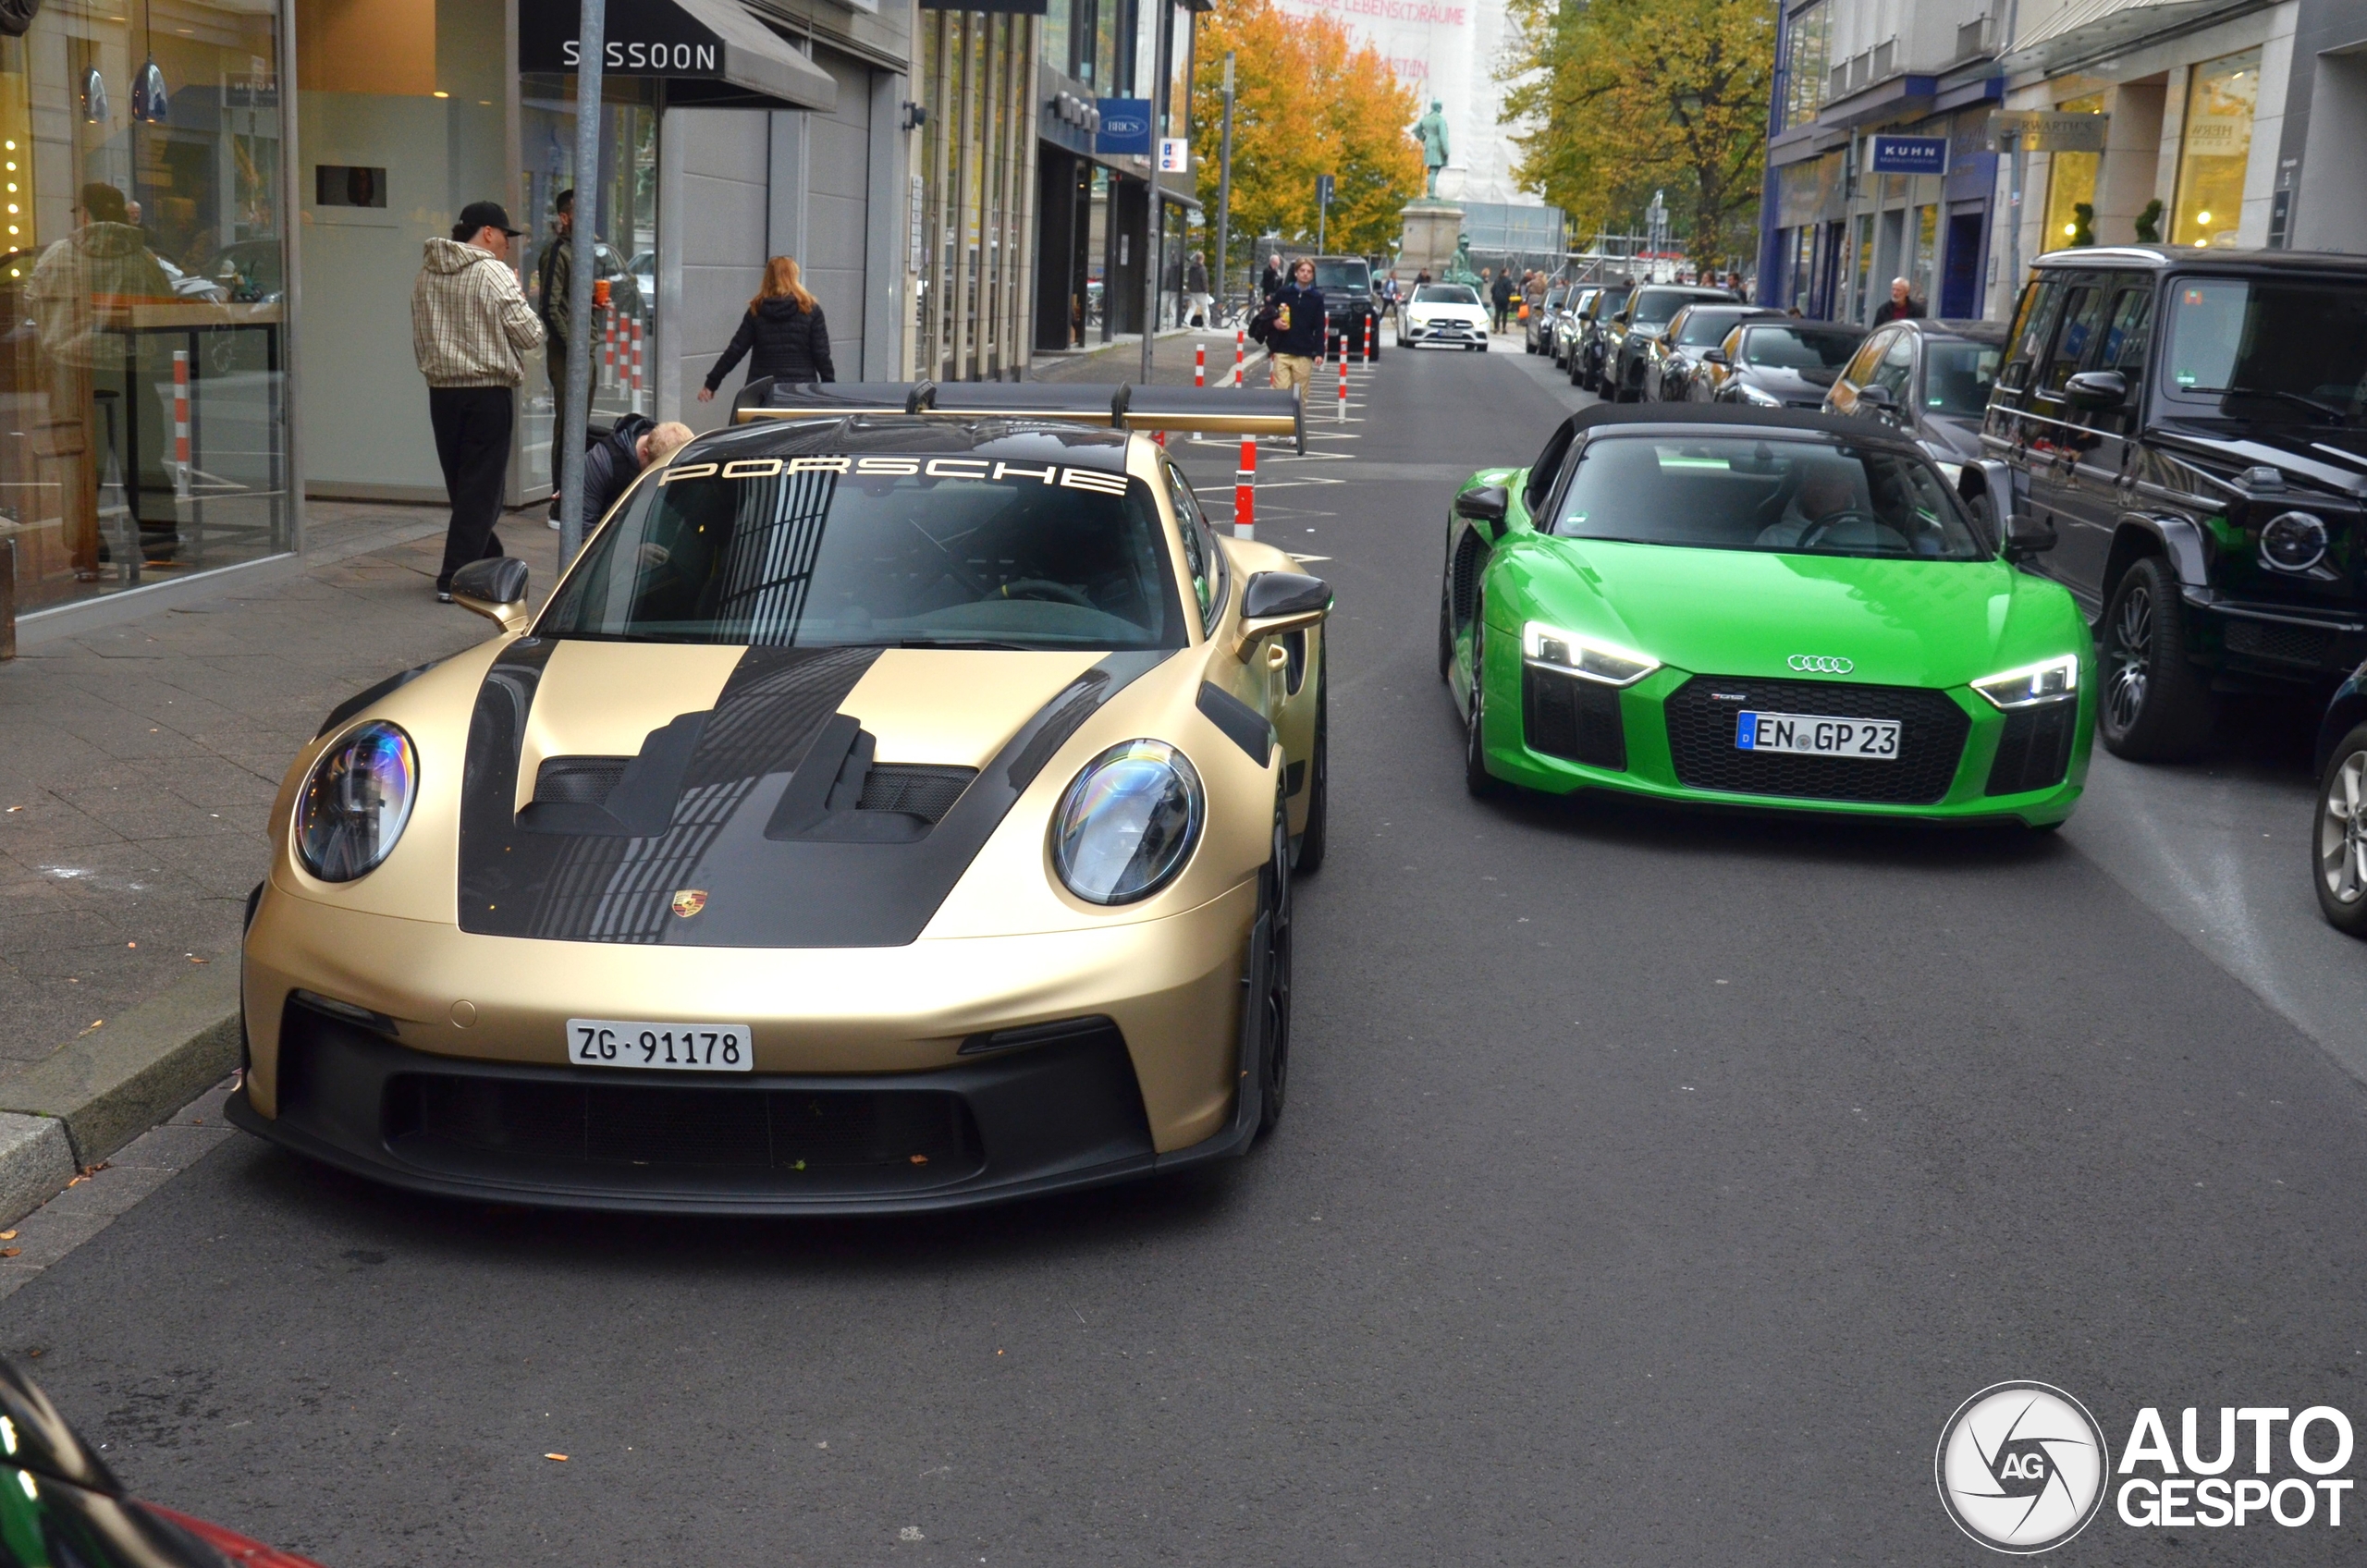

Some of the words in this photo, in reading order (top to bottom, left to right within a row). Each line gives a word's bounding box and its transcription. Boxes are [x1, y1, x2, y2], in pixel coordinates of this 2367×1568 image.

[562, 40, 715, 70] SSSOON
[1884, 145, 1936, 157] KUHN
[656, 457, 1129, 497] PORSCHE
[1742, 734, 1750, 743] D
[1755, 718, 1796, 749] EN
[1813, 722, 1854, 752] GP
[1858, 725, 1897, 755] 23
